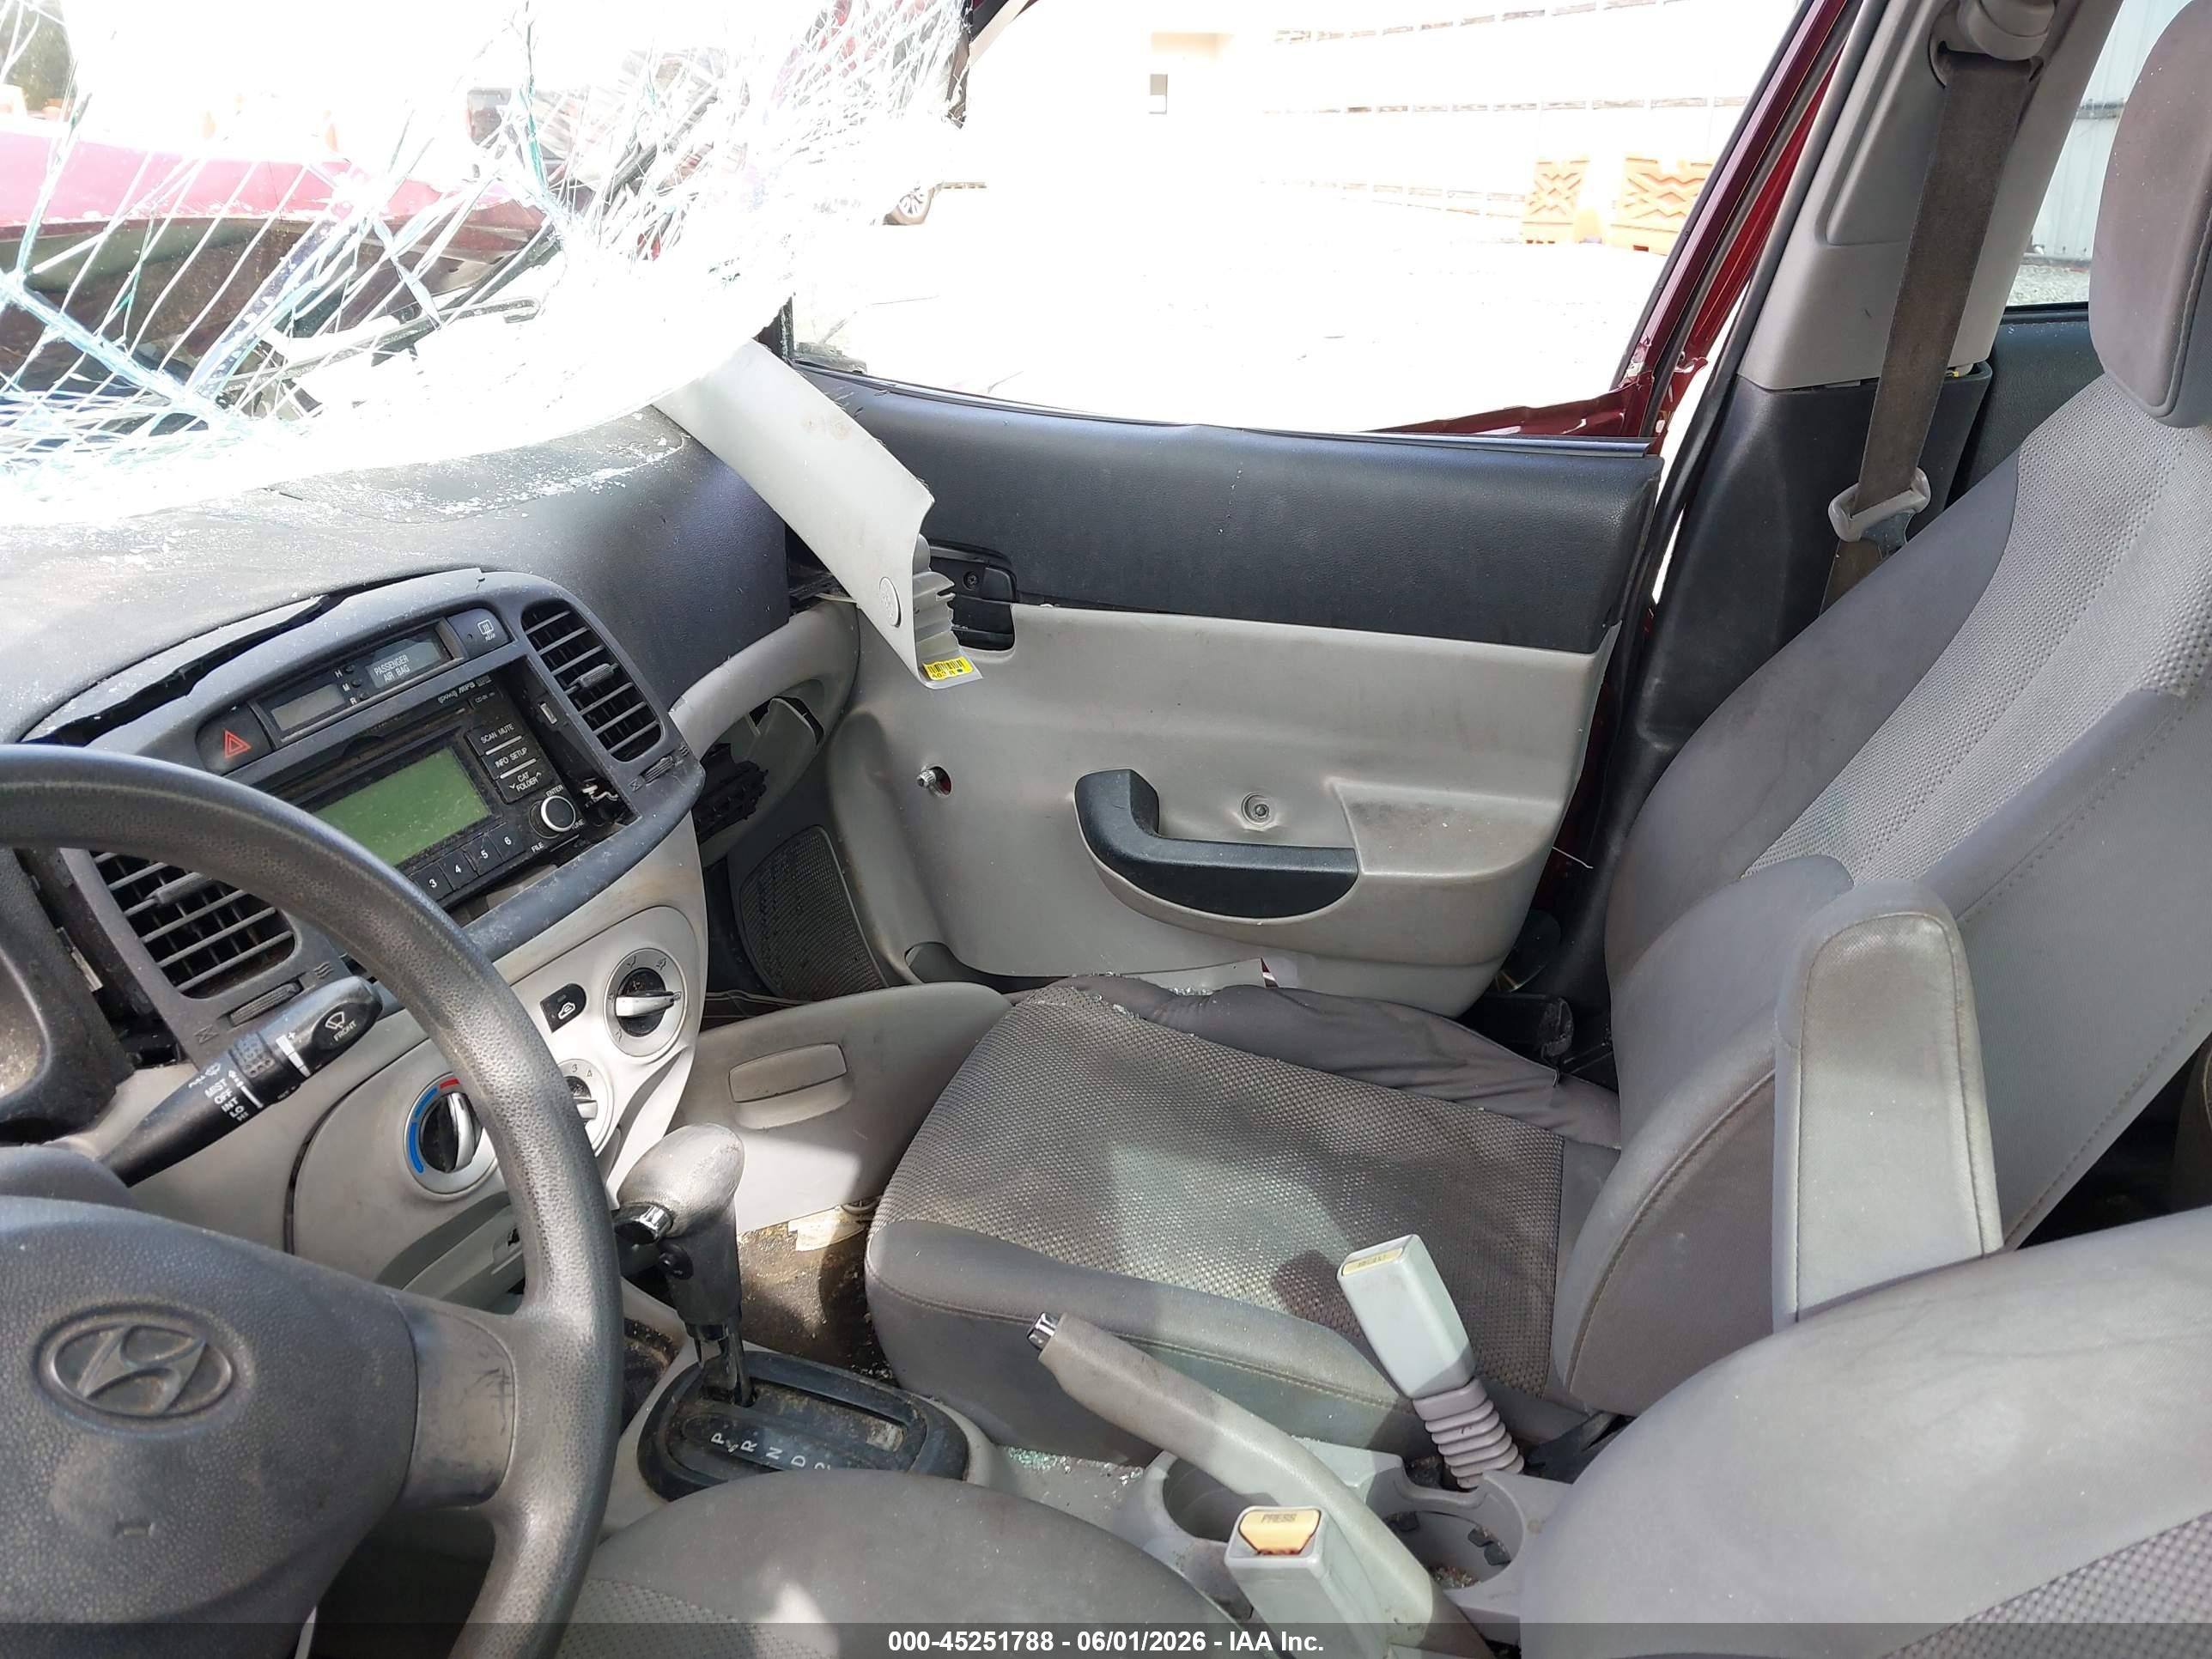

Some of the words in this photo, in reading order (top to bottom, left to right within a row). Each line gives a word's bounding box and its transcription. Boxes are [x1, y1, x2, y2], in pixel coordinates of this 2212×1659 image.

[374, 654, 409, 676] PASSENGER
[335, 670, 343, 678] H
[383, 672, 394, 682] AIR
[396, 664, 410, 678] BAG
[343, 684, 349, 692] M
[349, 696, 357, 705] R
[481, 732, 497, 744] SCAN
[498, 723, 514, 736] MUTE
[495, 757, 509, 769] INFO
[511, 747, 527, 761] SETUP
[517, 771, 529, 782] CAT
[515, 776, 538, 793] FOLDER
[546, 784, 564, 798] ENTER
[504, 836, 512, 846] 6
[531, 842, 544, 854] FILE
[480, 849, 489, 860] 5
[454, 865, 461, 874] 4
[429, 878, 437, 888] 3
[333, 1020, 357, 1042] FRONT
[571, 1063, 578, 1073] 3
[586, 1069, 592, 1078] 4
[204, 1078, 228, 1098] MIST
[214, 1088, 233, 1105] OFF
[221, 1097, 239, 1112] INT
[229, 1105, 245, 1118] LO
[711, 1432, 725, 1444] P
[740, 1439, 757, 1453] R
[766, 1446, 783, 1460] N
[791, 1455, 806, 1468] D
[1261, 1513, 1297, 1524] PRESS
